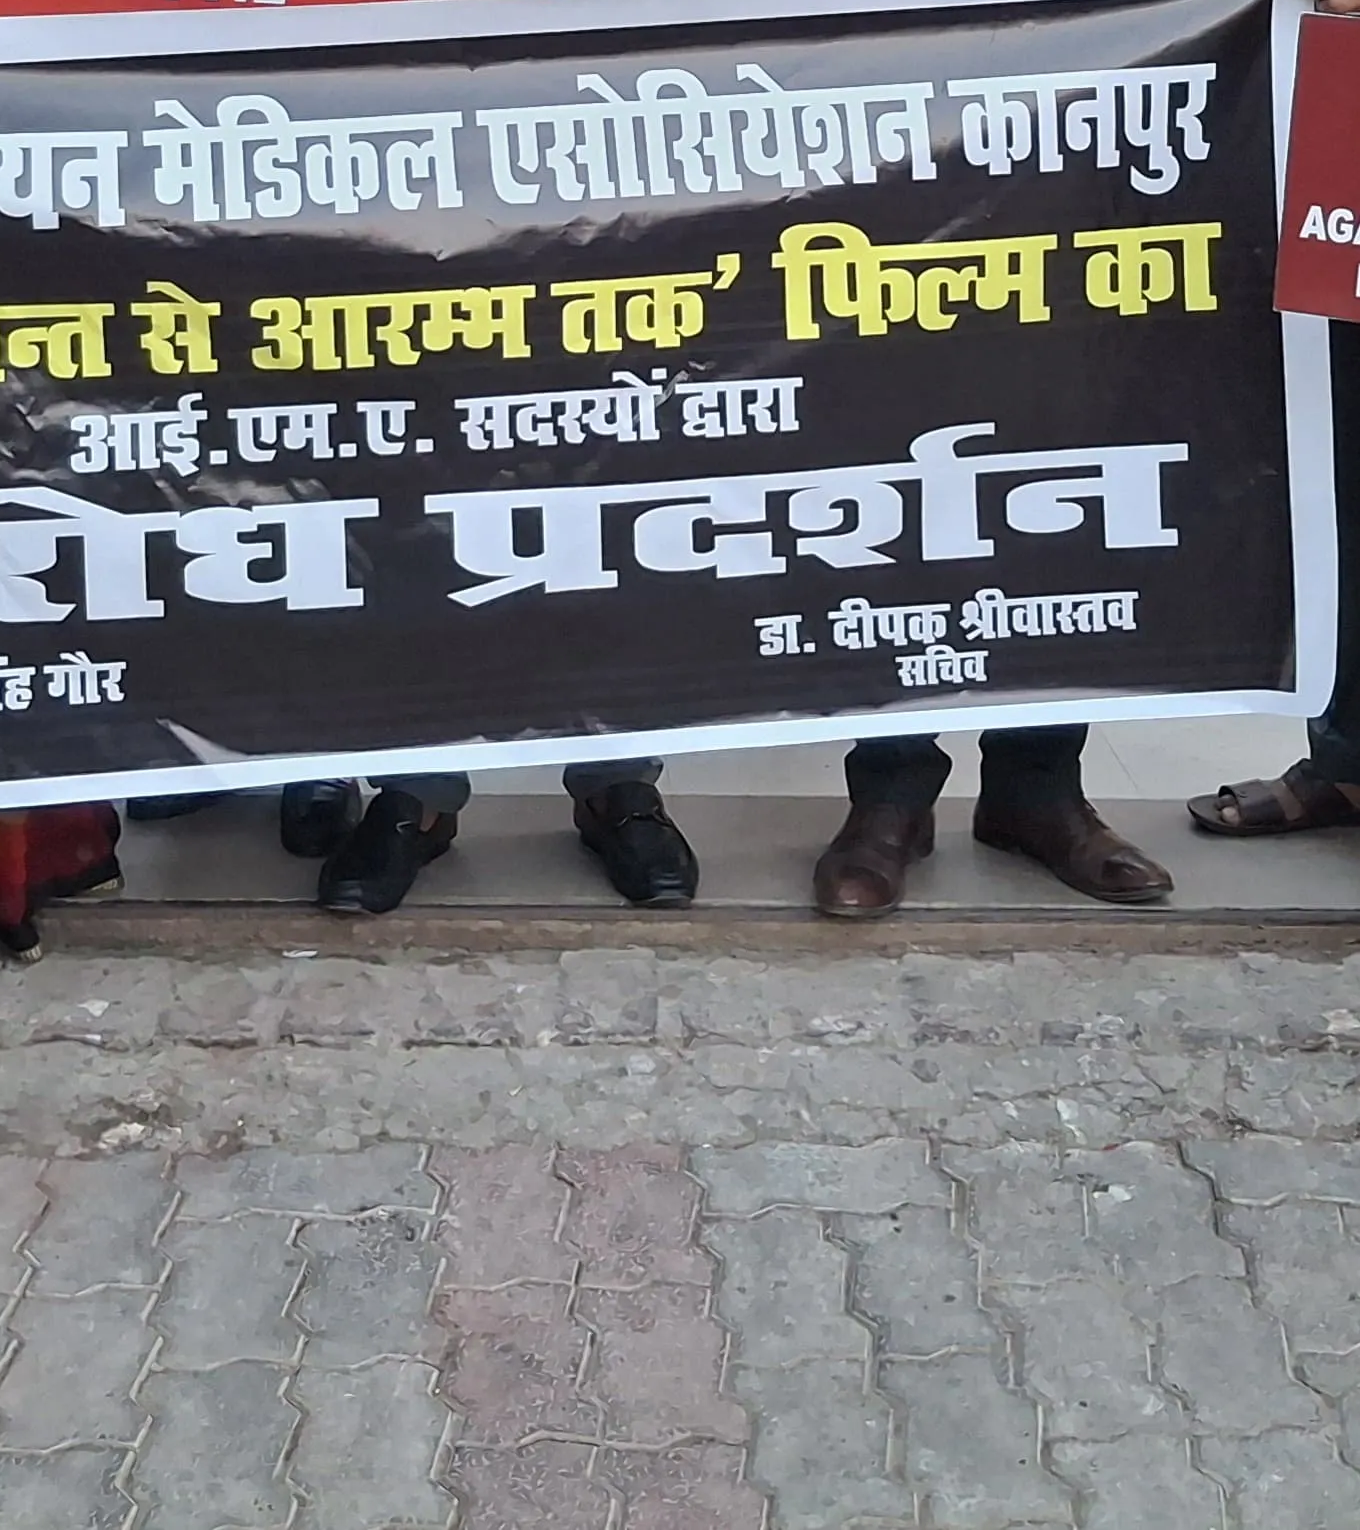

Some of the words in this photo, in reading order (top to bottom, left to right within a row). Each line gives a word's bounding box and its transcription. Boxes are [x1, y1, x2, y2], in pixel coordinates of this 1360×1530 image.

[141, 93, 464, 224] मेडिकल
[475, 62, 937, 207] एसोसियेशन
[948, 61, 1218, 198] कानपुर
[130, 281, 222, 376] से
[771, 221, 1057, 340] फिल्म
[1071, 221, 1222, 316] का
[69, 392, 435, 478] आई.एम.ए.
[454, 368, 668, 450] सदस्यों
[675, 376, 803, 438] द्वारा
[424, 422, 1189, 608] प्रदर्शन
[754, 615, 816, 656] डा.
[828, 598, 951, 650] दीपक
[959, 587, 1139, 642] श्रीवास्तव
[895, 645, 989, 687] सचिव
[43, 651, 126, 705] गौर
